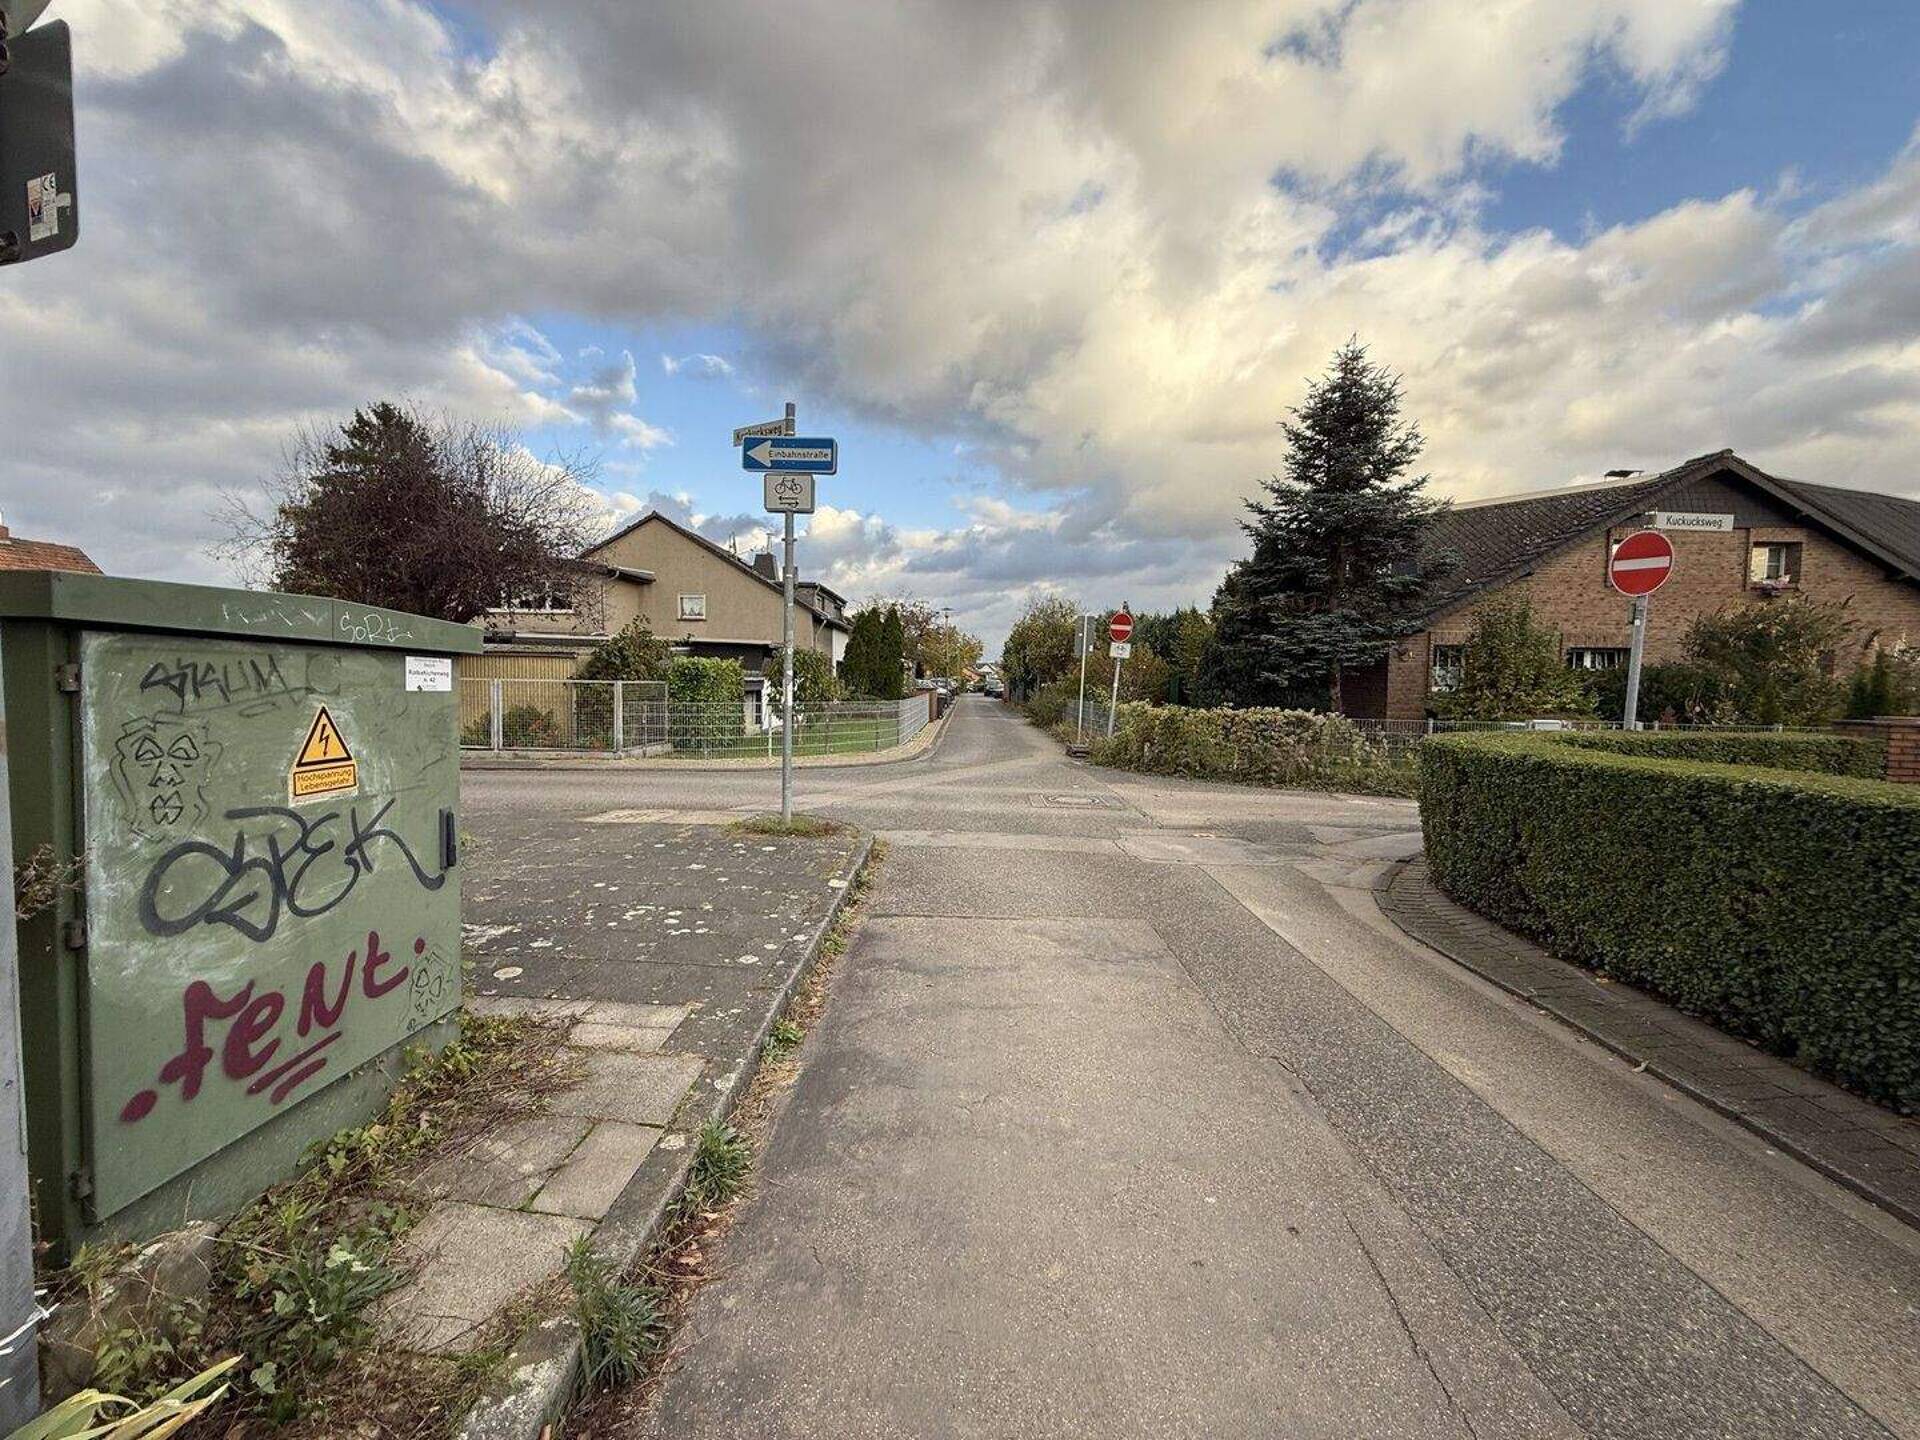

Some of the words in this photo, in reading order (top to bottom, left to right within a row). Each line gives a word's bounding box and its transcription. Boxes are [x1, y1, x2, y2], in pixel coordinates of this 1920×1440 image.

[768, 450, 829, 459] Einbahnstraße
[1666, 515, 1722, 528] Kuckucksweg
[297, 769, 352, 782] Hochspannung
[300, 776, 349, 791] Lebensgefahr
